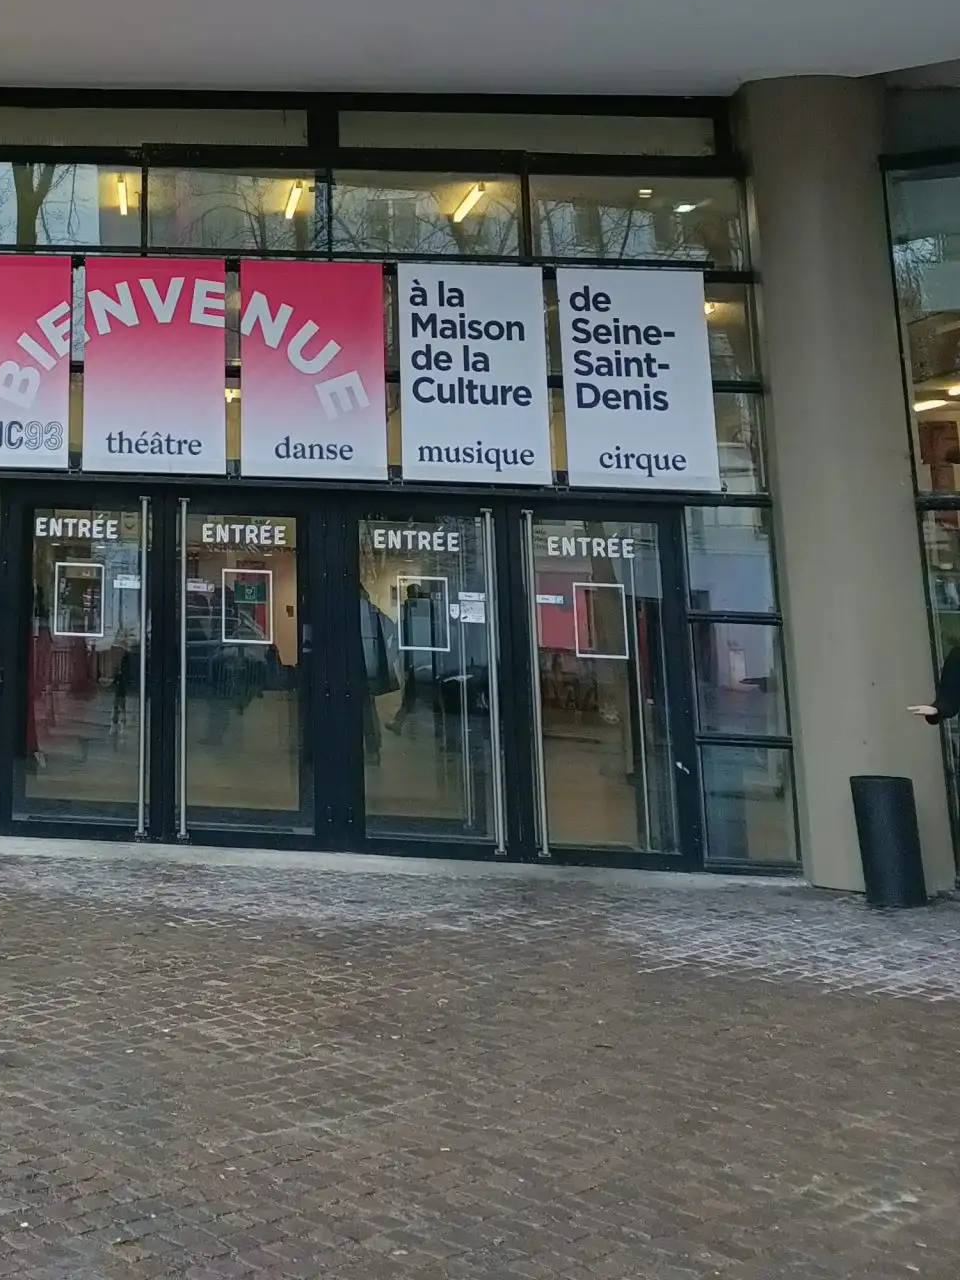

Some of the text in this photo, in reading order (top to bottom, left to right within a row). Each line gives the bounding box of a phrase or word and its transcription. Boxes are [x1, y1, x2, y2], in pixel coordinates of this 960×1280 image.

[409, 279, 464, 308] à la
[569, 285, 611, 312] de
[411, 313, 525, 341] Maison
[571, 318, 676, 346] Seine-
[411, 344, 490, 372] de la
[573, 349, 670, 378] Saint-
[412, 376, 533, 407] Culture
[576, 382, 669, 411] Denis
[106, 431, 202, 456] théâtre
[274, 436, 354, 460] danse
[418, 441, 535, 472] musique
[599, 445, 687, 478] cirque
[35, 514, 119, 539] ENTRÉE
[201, 520, 287, 545] ENTRÉE
[373, 526, 460, 552] ENTRÉE
[547, 532, 636, 558] ENTRÉE
